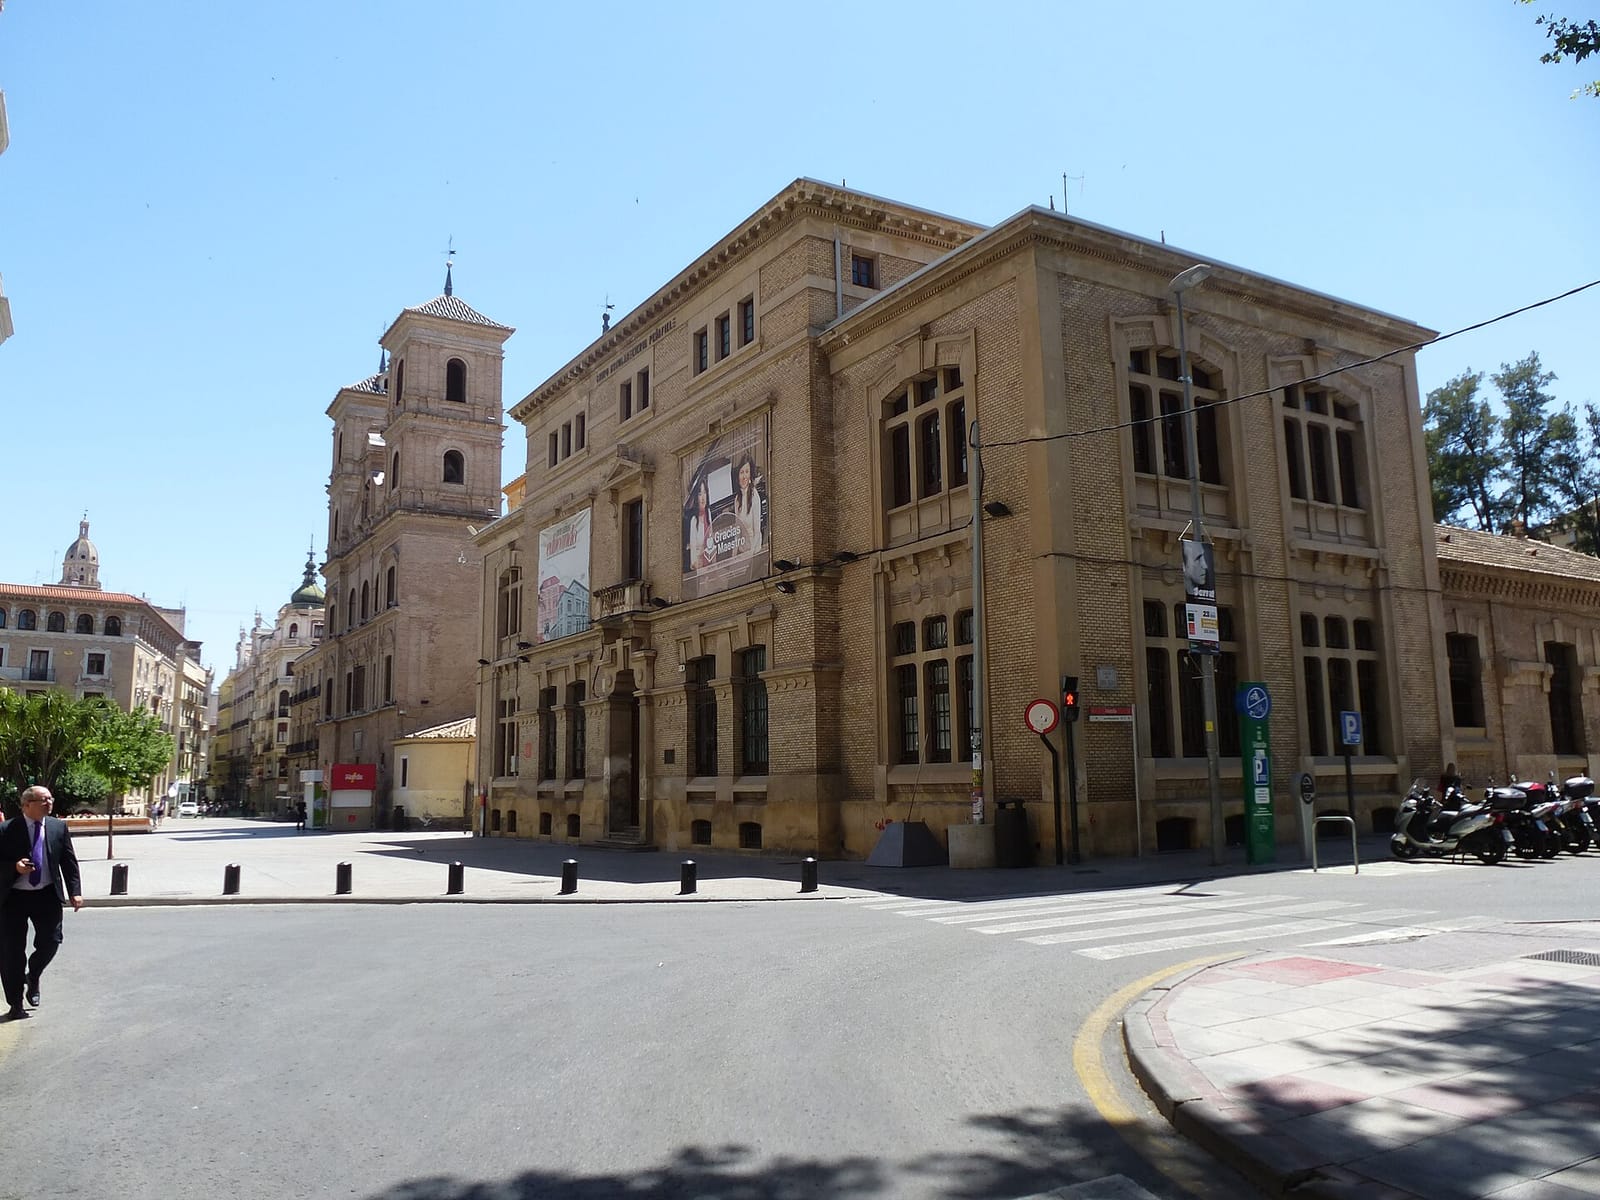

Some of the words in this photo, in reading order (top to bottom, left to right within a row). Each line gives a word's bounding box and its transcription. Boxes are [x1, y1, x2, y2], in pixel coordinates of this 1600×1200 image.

[714, 525, 741, 543] Gracias
[717, 536, 745, 554] Maestro
[1345, 715, 1357, 740] P
[1254, 759, 1262, 781] P
